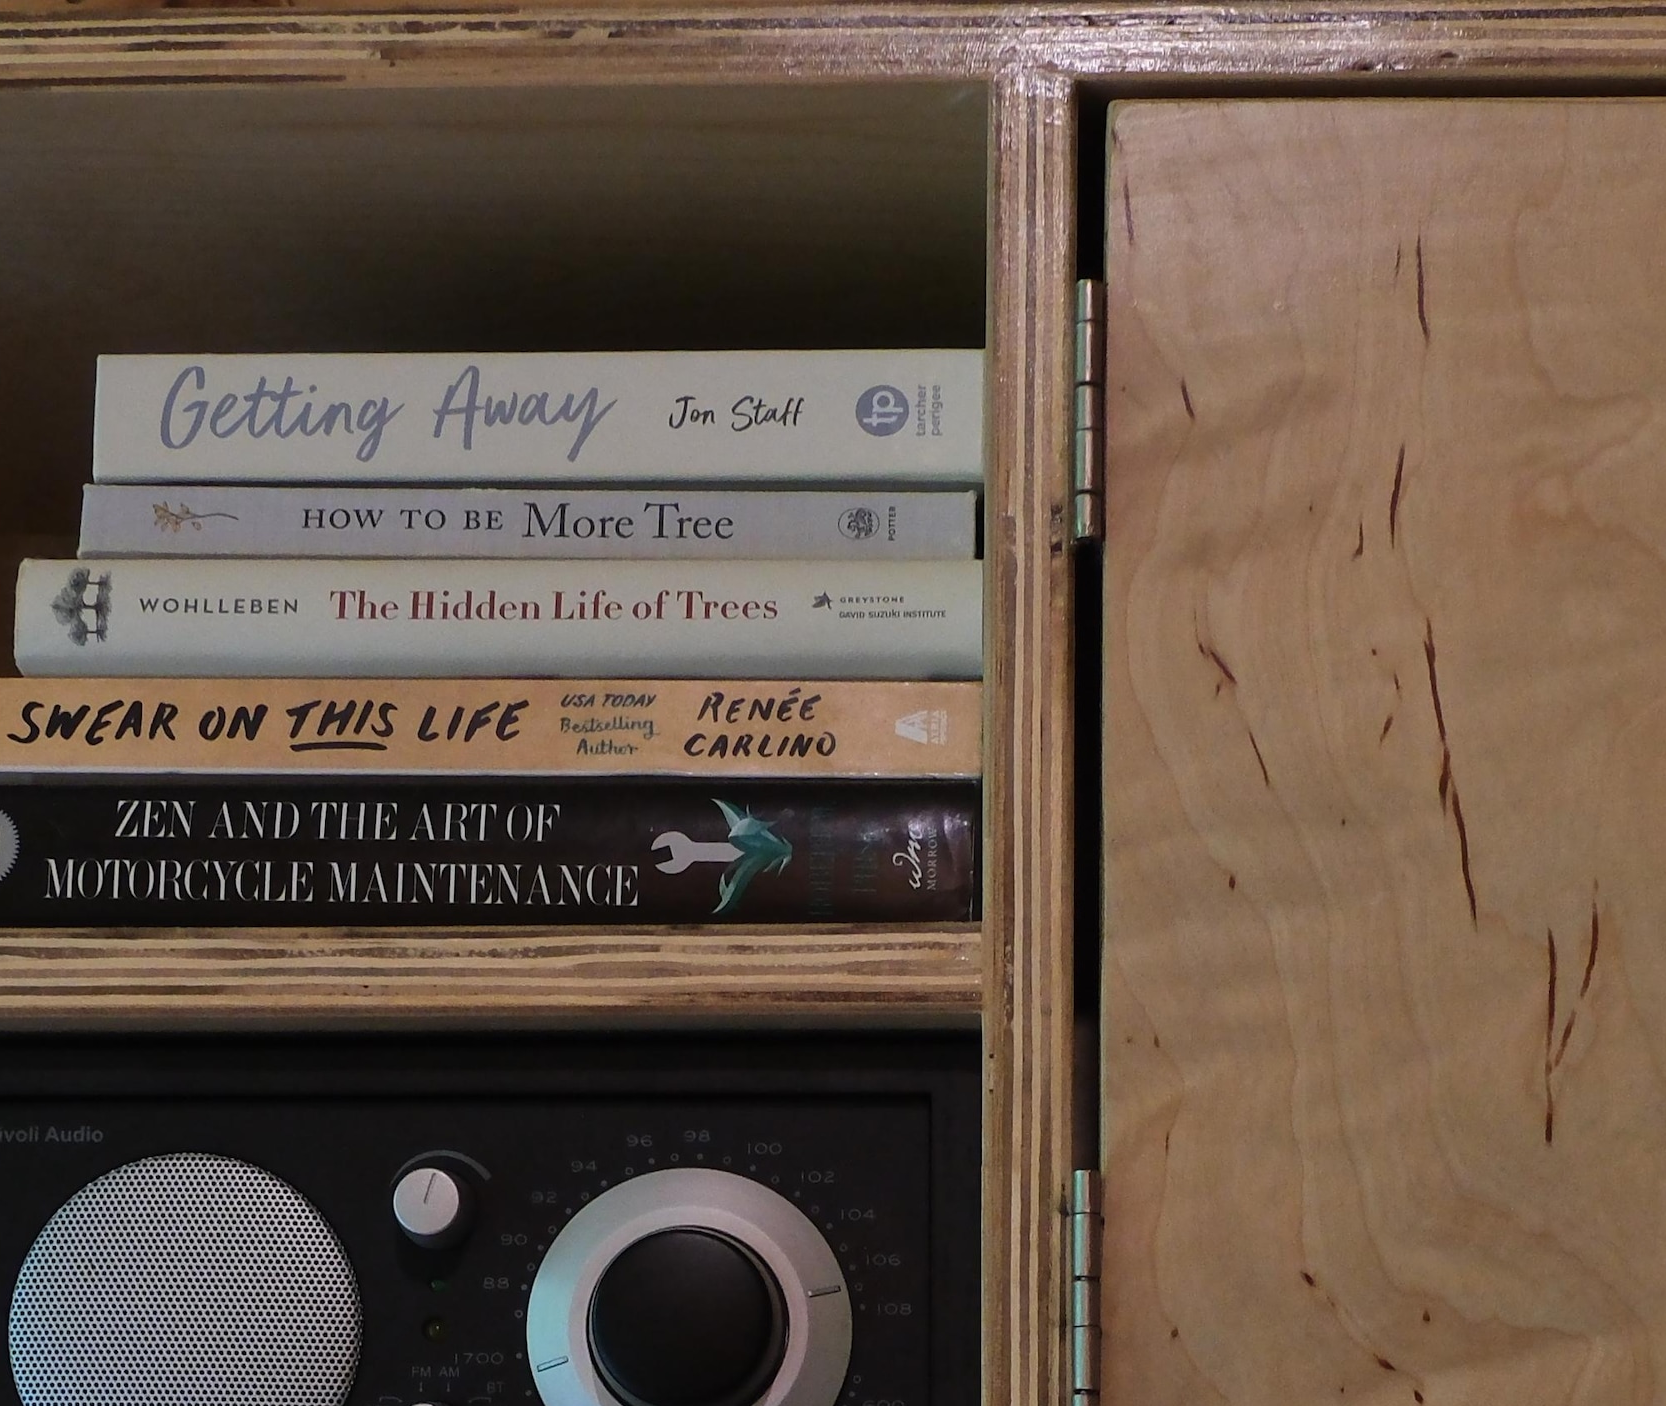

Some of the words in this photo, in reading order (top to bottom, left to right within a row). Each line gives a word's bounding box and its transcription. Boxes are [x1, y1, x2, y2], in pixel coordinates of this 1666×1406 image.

[159, 365, 406, 463] Getting
[433, 364, 618, 463] Away
[668, 395, 716, 430] Jon
[731, 395, 805, 432] Staff
[916, 384, 927, 437] tarcher
[929, 384, 944, 437] perigee
[301, 508, 384, 530] HOW
[399, 508, 447, 531] TO
[462, 509, 504, 531] BE
[521, 501, 635, 540] More
[643, 501, 734, 540] Tree
[888, 506, 897, 542] POTTER
[139, 597, 300, 615] WOHLLEBEN
[329, 590, 400, 621] The
[408, 590, 541, 621] Hidden
[551, 590, 623, 621] Life
[631, 590, 671, 621] of
[676, 590, 779, 621] Trees
[839, 596, 905, 604] GREYSTONE
[839, 610, 865, 619] DAVID
[903, 609, 947, 618] INSTITUTE
[560, 693, 596, 708] USA
[602, 693, 658, 708] TODAY
[697, 687, 822, 723] RENÉE
[7, 699, 177, 746] SWEAR
[198, 702, 269, 742] ON
[285, 699, 396, 740] THIS
[416, 699, 530, 743] LIFE
[560, 716, 661, 740] Bestselling
[576, 738, 639, 756] Author
[683, 732, 838, 758] CARLINO
[114, 800, 196, 838] ZEN
[208, 801, 301, 840] AND
[309, 802, 399, 841] THE
[409, 803, 498, 842] ART
[505, 804, 562, 843] OF
[43, 857, 315, 902] MOTORCYCLE
[327, 860, 639, 906] MAINTENANCE
[44, 1125, 104, 1143] Audio
[626, 1134, 653, 1148] 96
[684, 1129, 711, 1143] 98
[747, 1142, 783, 1155] 100
[570, 1159, 598, 1173] 94
[801, 1170, 835, 1183] 102
[531, 1190, 558, 1204] 92
[840, 1208, 876, 1221] 104
[500, 1233, 528, 1247] 90
[866, 1253, 902, 1267] 106
[483, 1276, 510, 1290] 88
[877, 1303, 913, 1316] 108
[454, 1351, 505, 1365] 1700
[411, 1365, 432, 1378] FM
[438, 1366, 460, 1378] AM
[486, 1381, 505, 1394] BT
